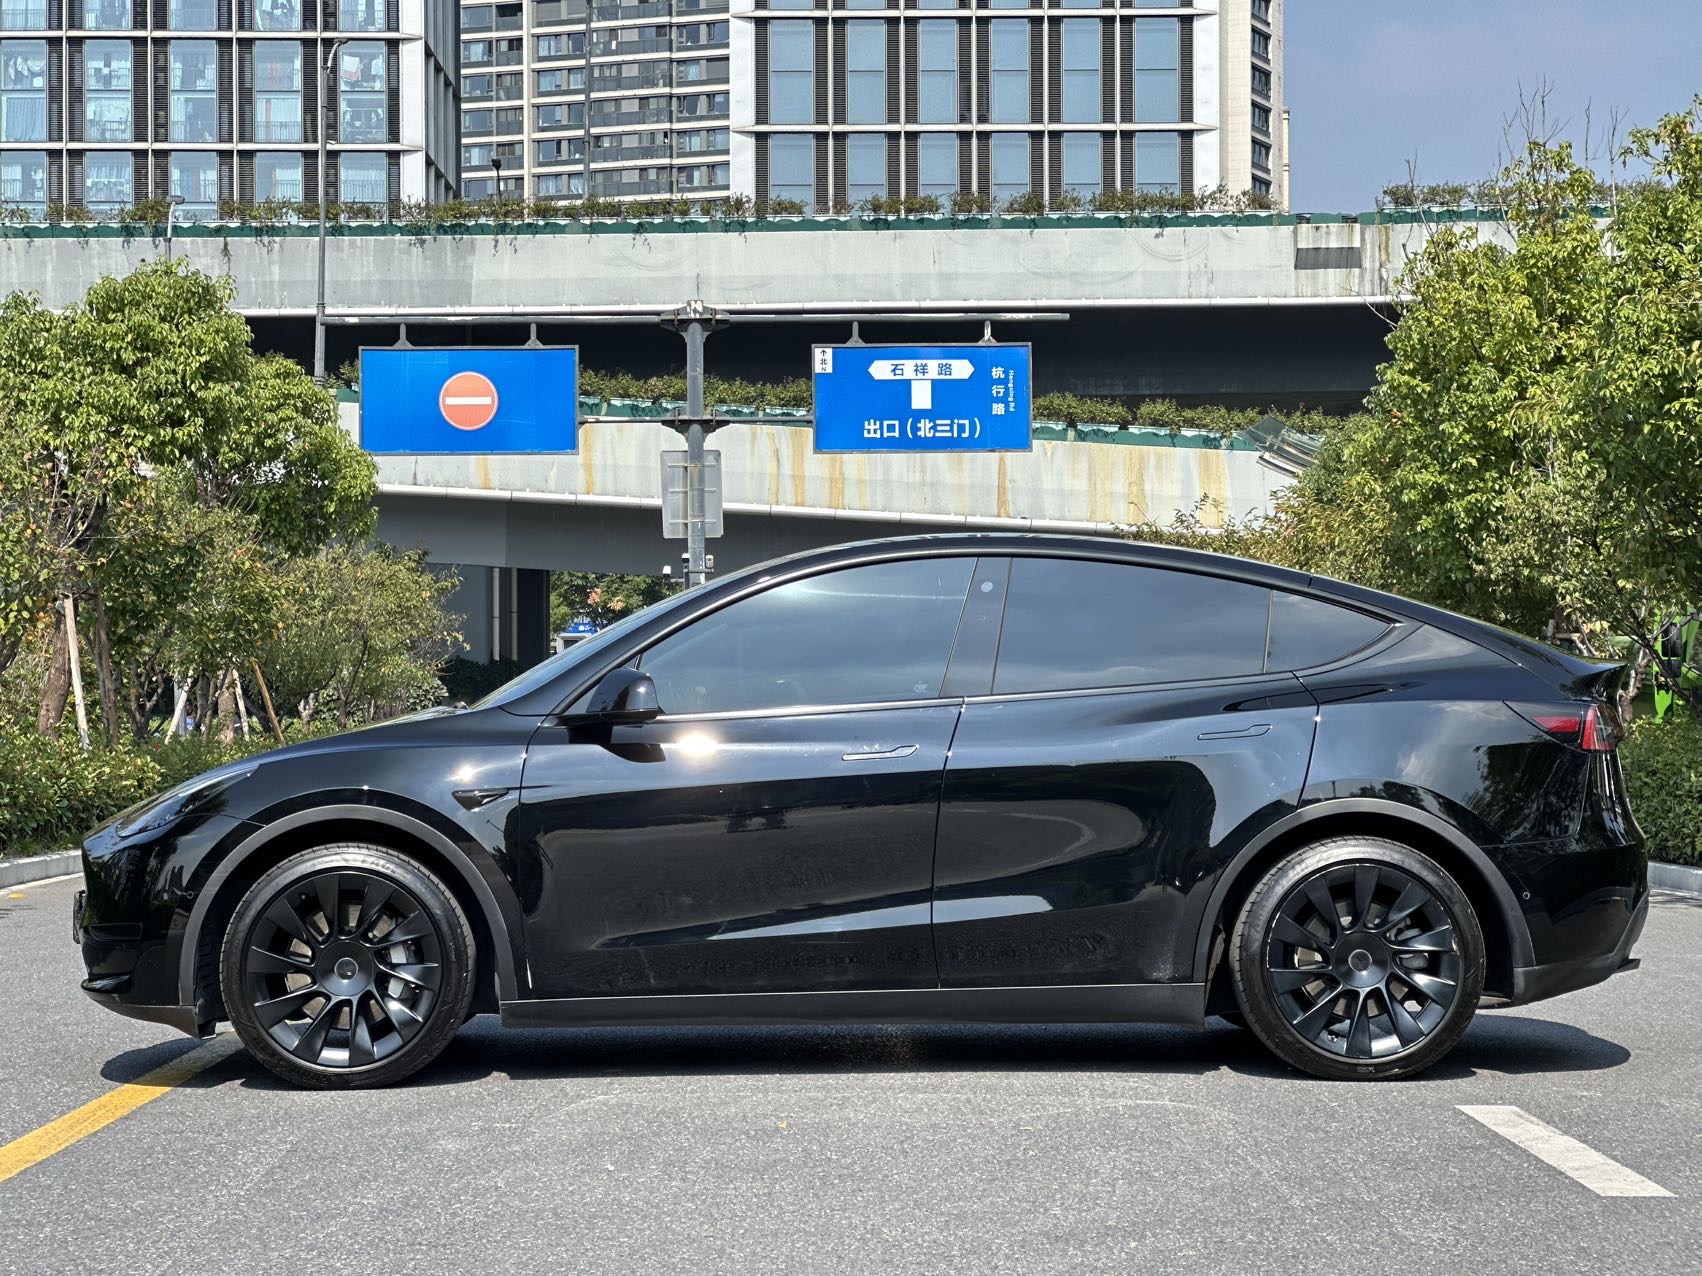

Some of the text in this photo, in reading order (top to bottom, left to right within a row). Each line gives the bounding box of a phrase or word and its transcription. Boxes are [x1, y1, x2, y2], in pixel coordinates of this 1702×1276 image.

[820, 357, 828, 366] 北
[890, 362, 953, 377] 石祥路
[991, 366, 1006, 416] 杭行路
[1009, 402, 1016, 412] Rd
